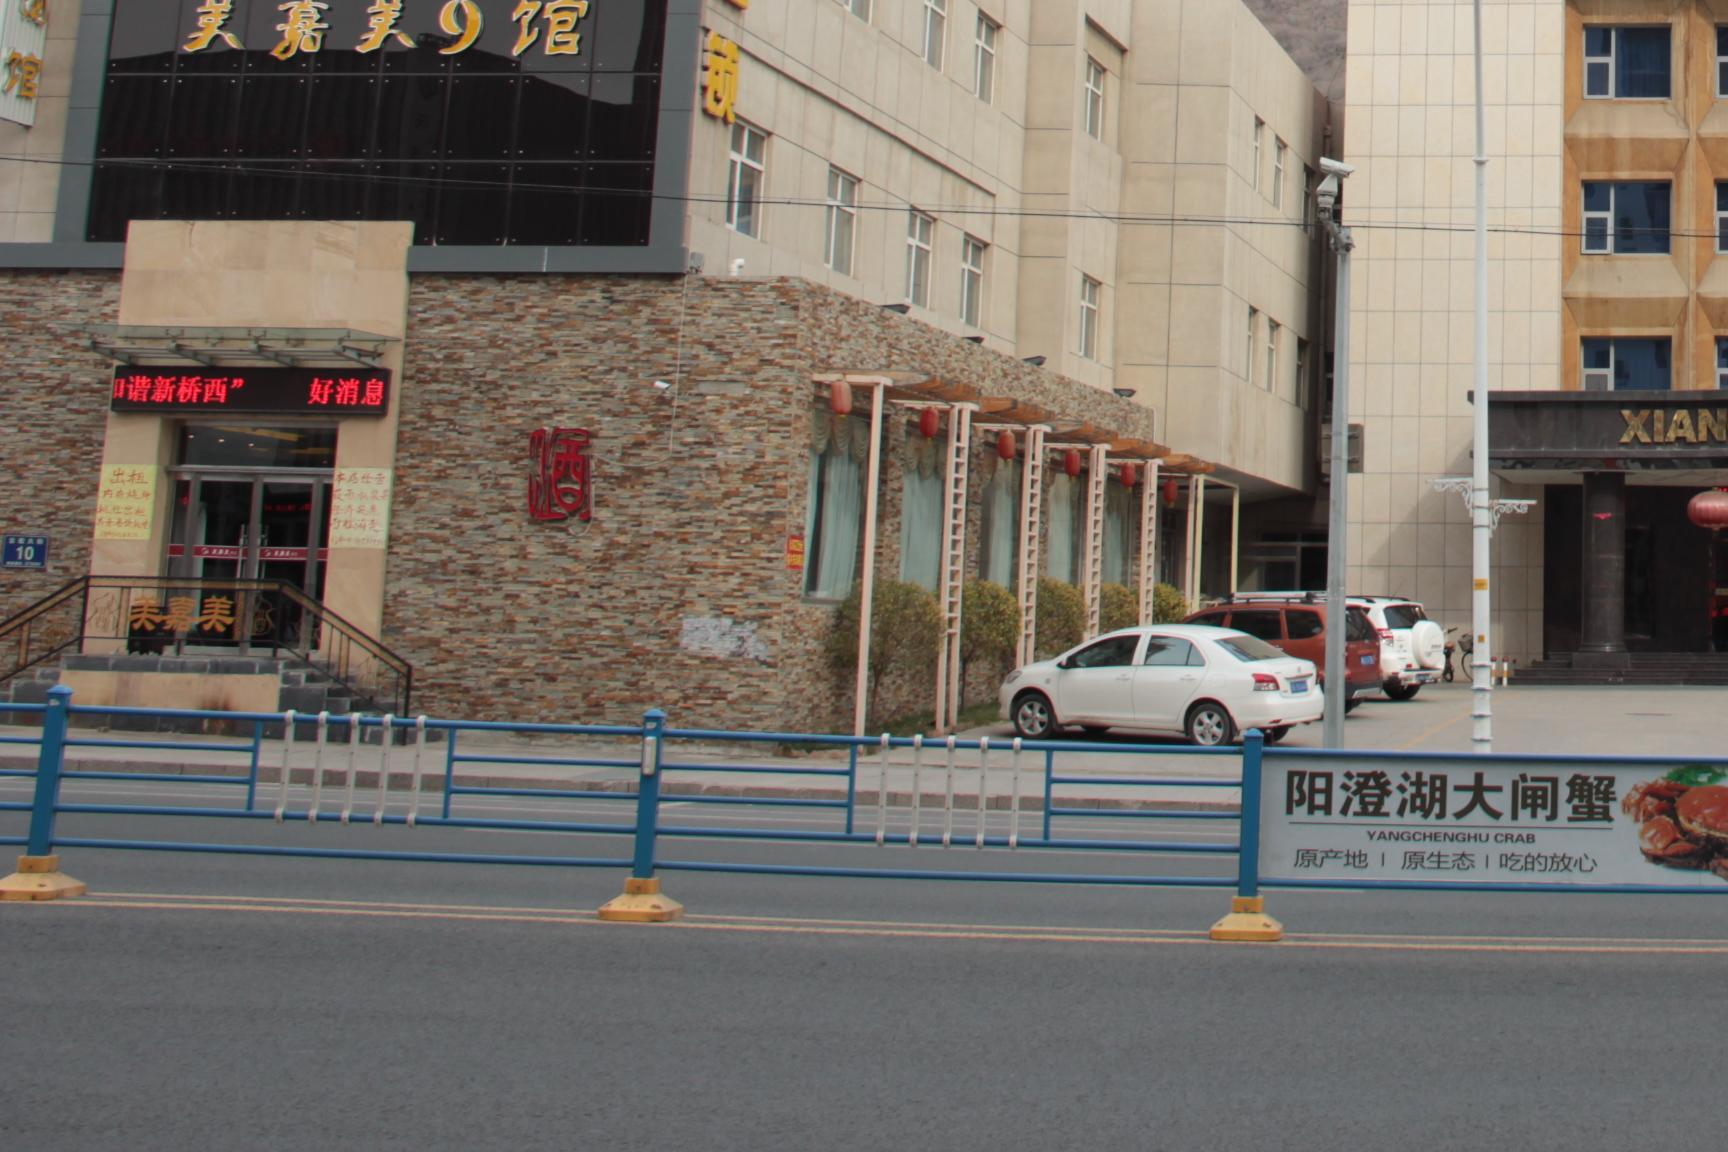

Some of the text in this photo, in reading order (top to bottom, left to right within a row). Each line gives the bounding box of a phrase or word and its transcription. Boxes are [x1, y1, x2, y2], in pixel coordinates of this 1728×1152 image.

[308, 378, 384, 406] 好消息
[16, 545, 35, 561] 10
[129, 594, 238, 634] 美嘉美
[1284, 769, 1618, 823] 阳澄湖大闸蟹
[1366, 829, 1536, 845] YANGCHENGHU CRAB
[1293, 848, 1598, 875] 原产地 原生态 吃的放心
